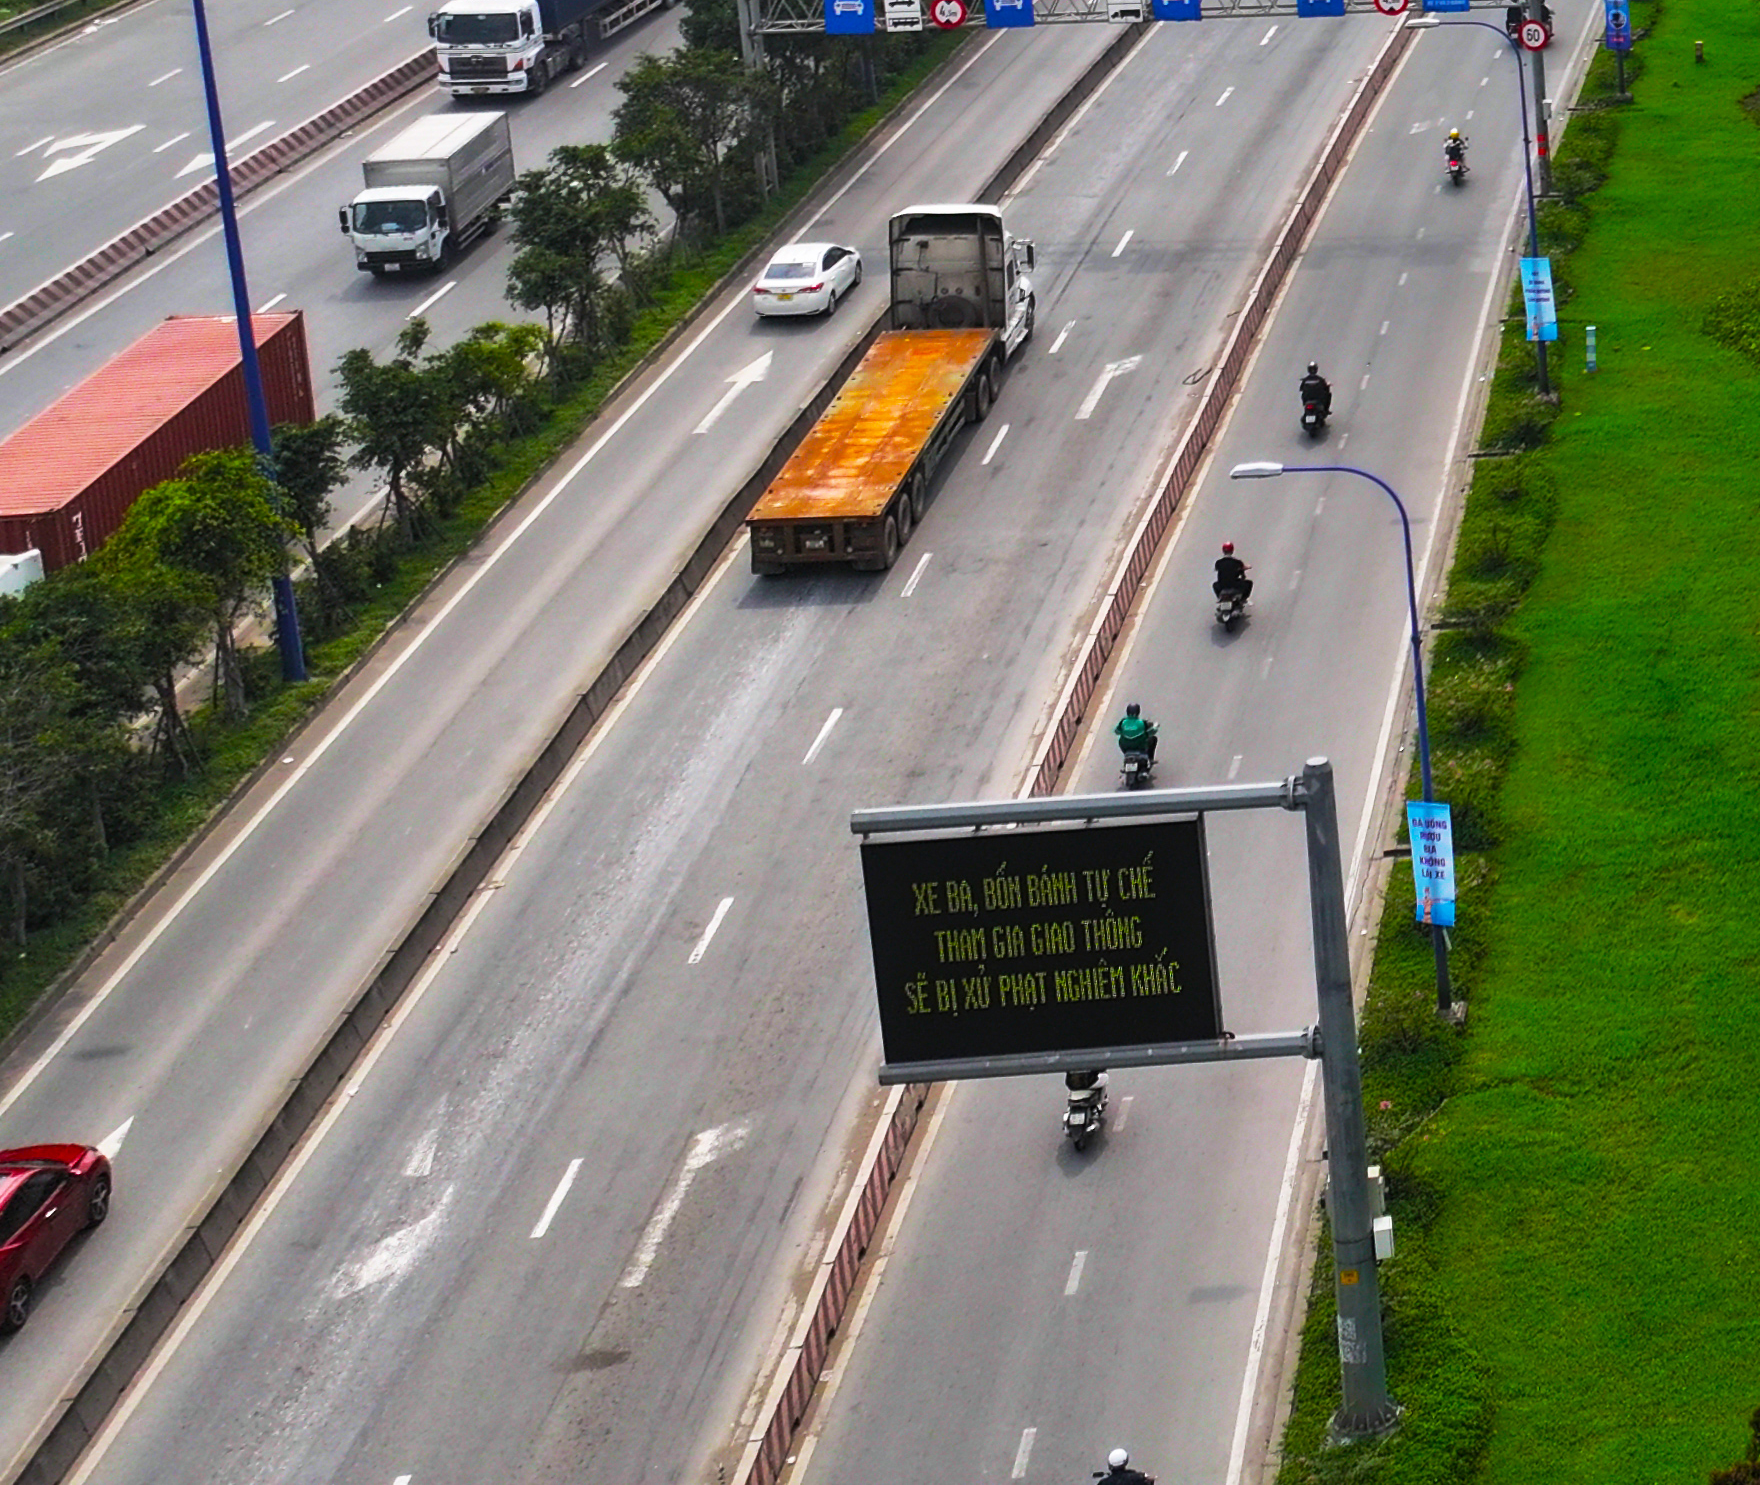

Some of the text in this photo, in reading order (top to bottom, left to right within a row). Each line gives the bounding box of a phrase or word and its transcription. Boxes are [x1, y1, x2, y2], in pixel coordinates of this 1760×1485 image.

[1527, 29, 1540, 42] 60
[911, 850, 1157, 917] XE BA, BỐN BÁNH TỰ CHẾ
[934, 908, 1144, 963] THAM GIA GIAO THÔNG
[904, 946, 1182, 1017] SẼ BỊ XỬ PHẠT NGHIÊM KHẮC
